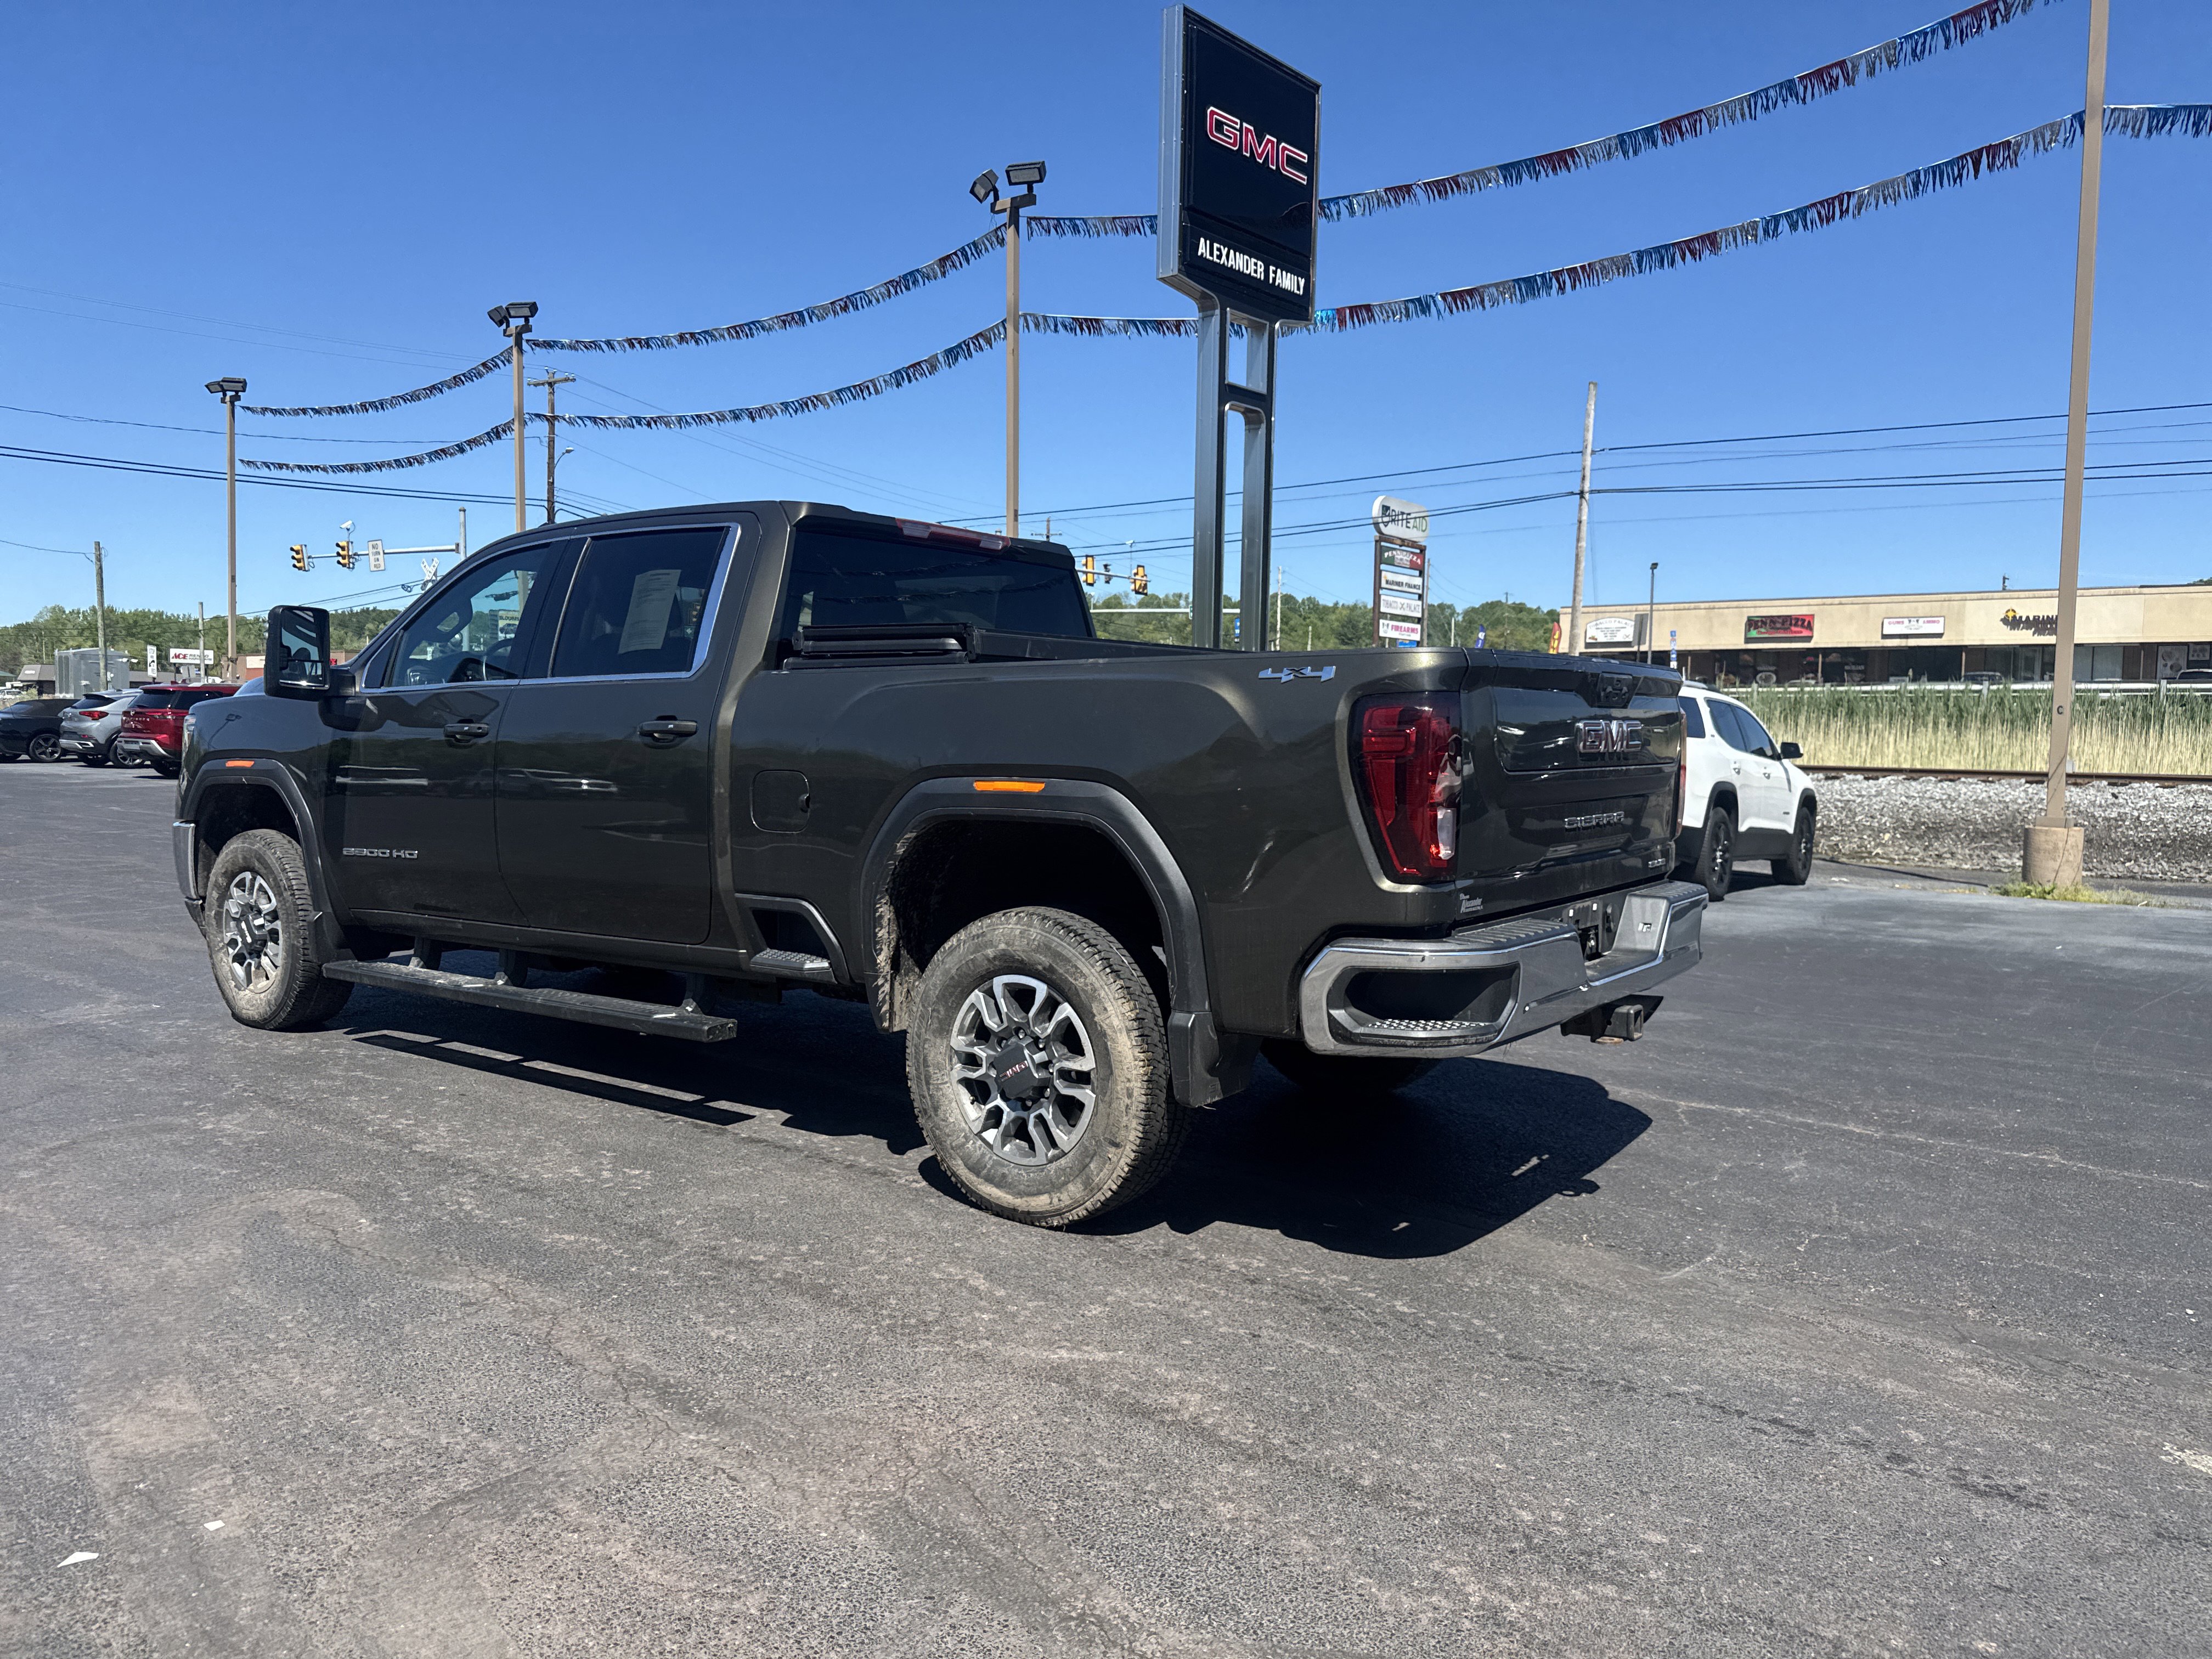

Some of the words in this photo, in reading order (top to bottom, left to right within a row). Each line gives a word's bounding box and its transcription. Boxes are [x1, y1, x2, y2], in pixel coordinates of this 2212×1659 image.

[1206, 106, 1308, 186] GMC
[1197, 236, 1264, 281] ALEXANDER
[1268, 265, 1305, 296] FAMILY
[1391, 509, 1411, 529] RITE
[1412, 516, 1427, 533] AID
[1385, 579, 1404, 588] MARINER
[1404, 582, 1421, 591] FINANCE
[1391, 624, 1419, 635] FIREARMS
[171, 652, 189, 660] ACE
[1575, 719, 1642, 753] GMC
[1564, 811, 1624, 830] SIERRA
[392, 849, 419, 859] HD
[1000, 1060, 1029, 1082] GMC
